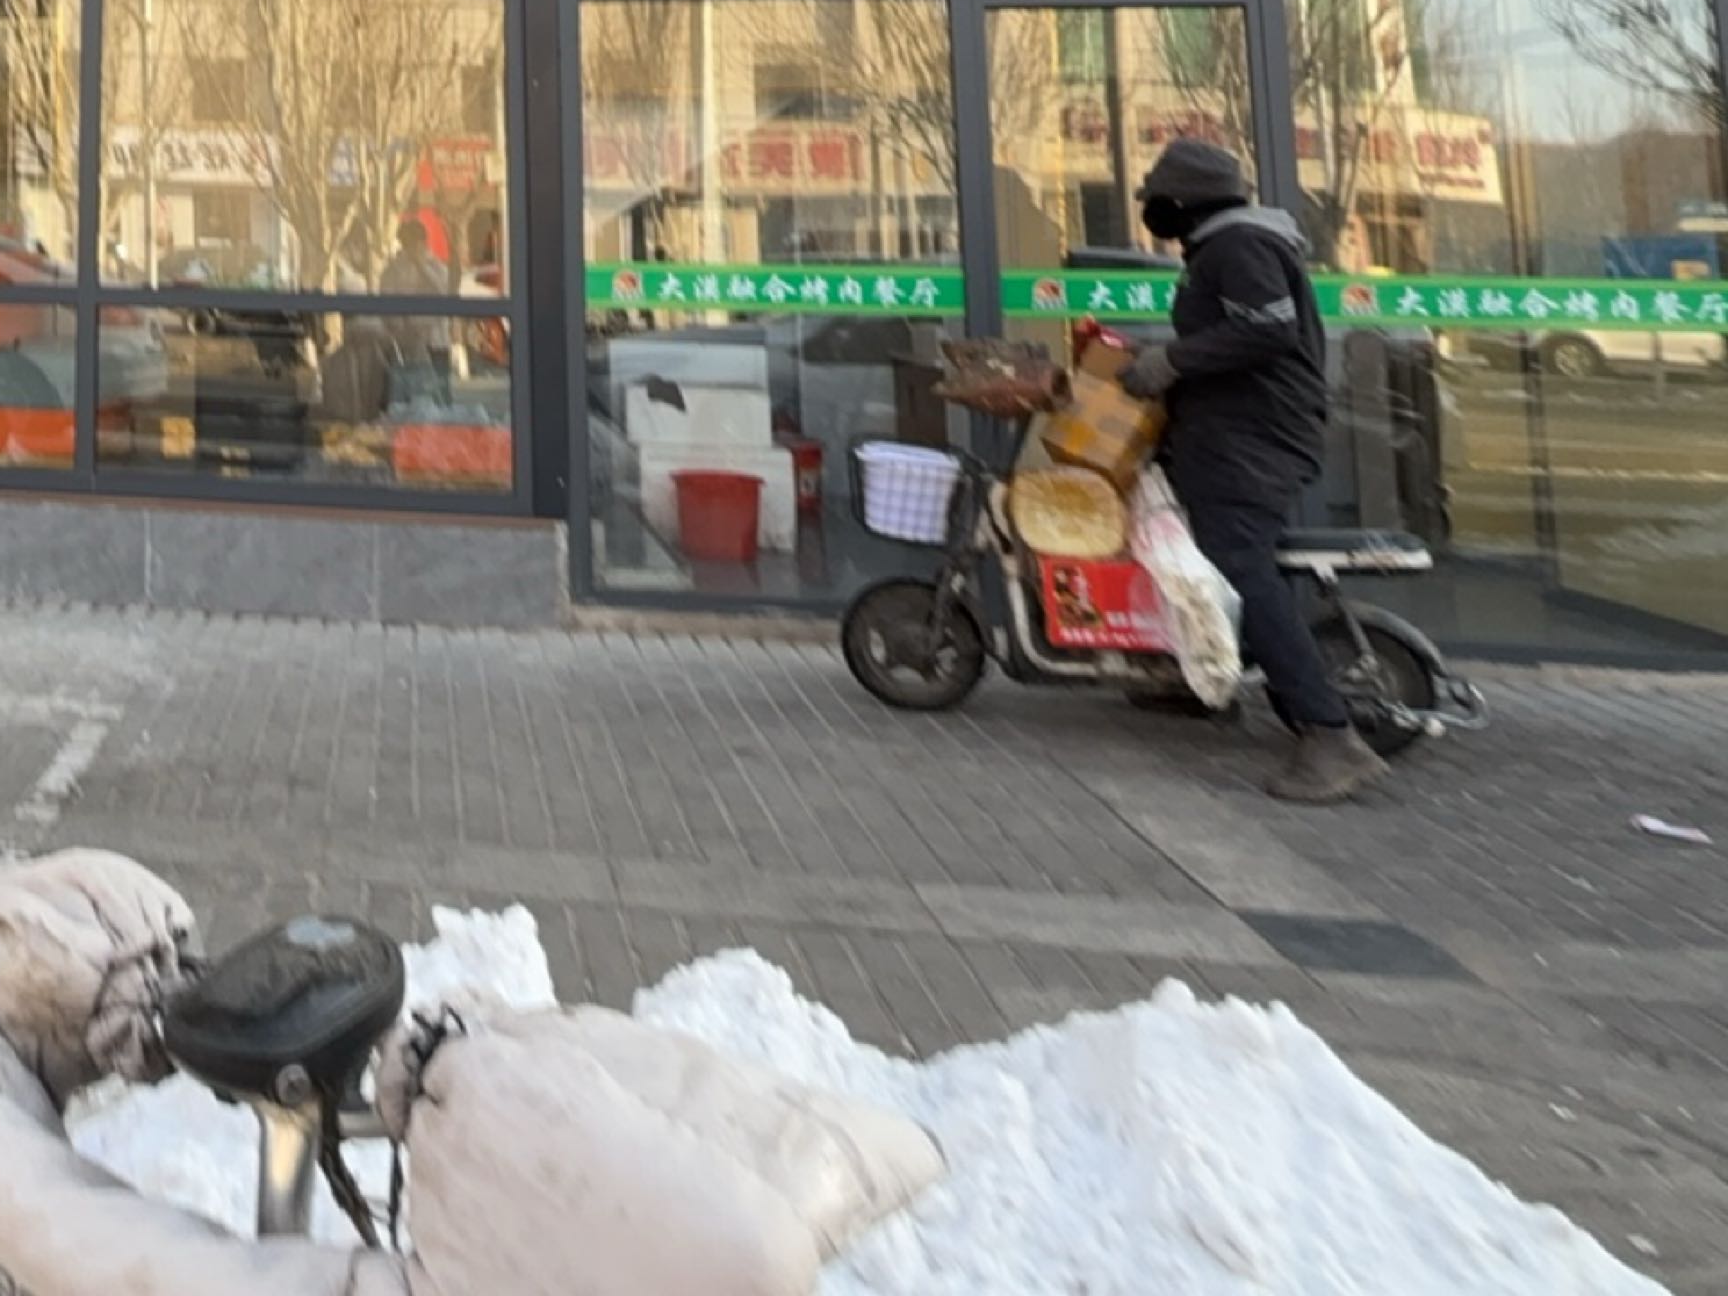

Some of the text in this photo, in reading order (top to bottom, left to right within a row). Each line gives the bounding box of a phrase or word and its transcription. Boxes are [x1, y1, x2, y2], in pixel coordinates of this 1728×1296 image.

[657, 272, 940, 309] 大漠融合烤肉餐厅
[1087, 279, 1177, 313] 大漠
[1396, 286, 1728, 324] 大漠融合烤肉餐厅
